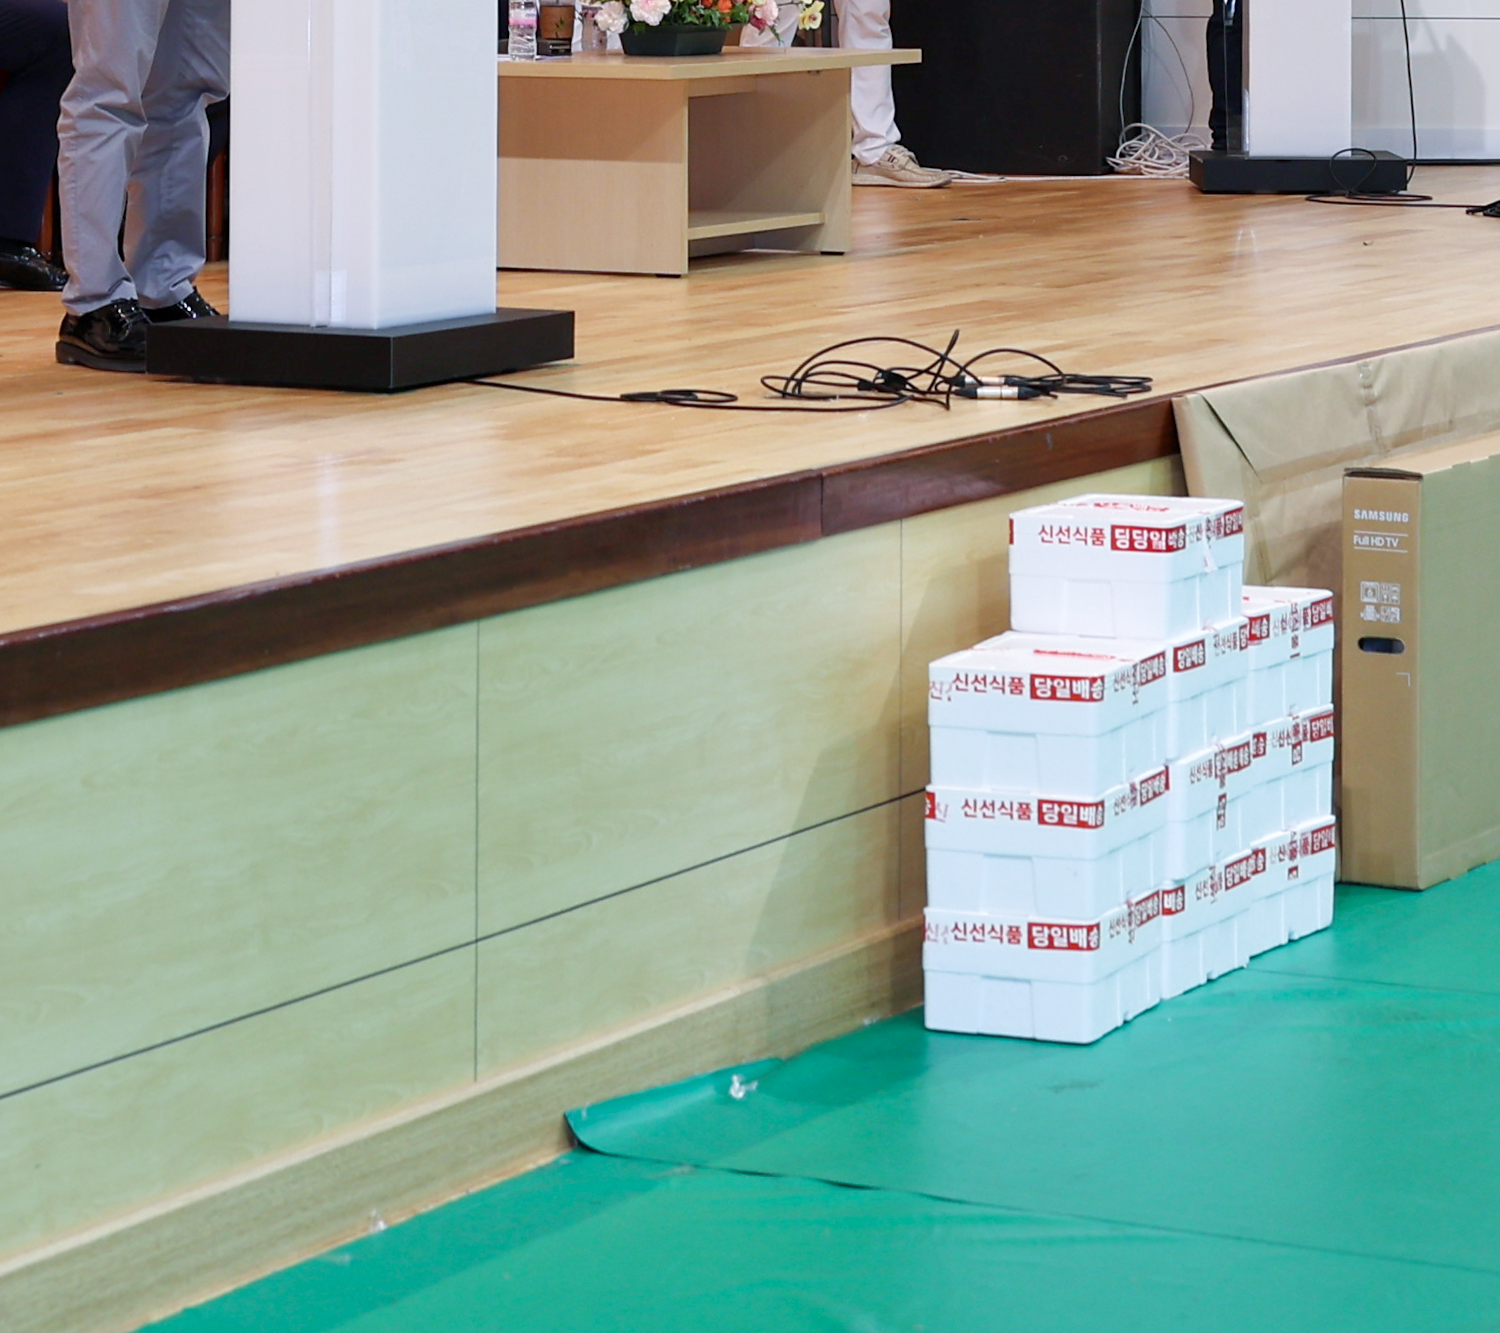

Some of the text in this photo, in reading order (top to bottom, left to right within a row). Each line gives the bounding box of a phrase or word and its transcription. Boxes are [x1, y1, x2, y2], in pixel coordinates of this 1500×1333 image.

[1353, 509, 1409, 523] SAMSUNG
[1038, 524, 1106, 547] 신선식품
[1353, 535, 1398, 548] Full HD TV
[952, 672, 1025, 696] 신선식품
[1034, 677, 1104, 700] 당일배송
[961, 799, 1033, 821] 신선식품
[1041, 803, 1104, 826] 당일배송
[951, 922, 1021, 945] 신선식품
[1032, 926, 1099, 949] 당일배송
